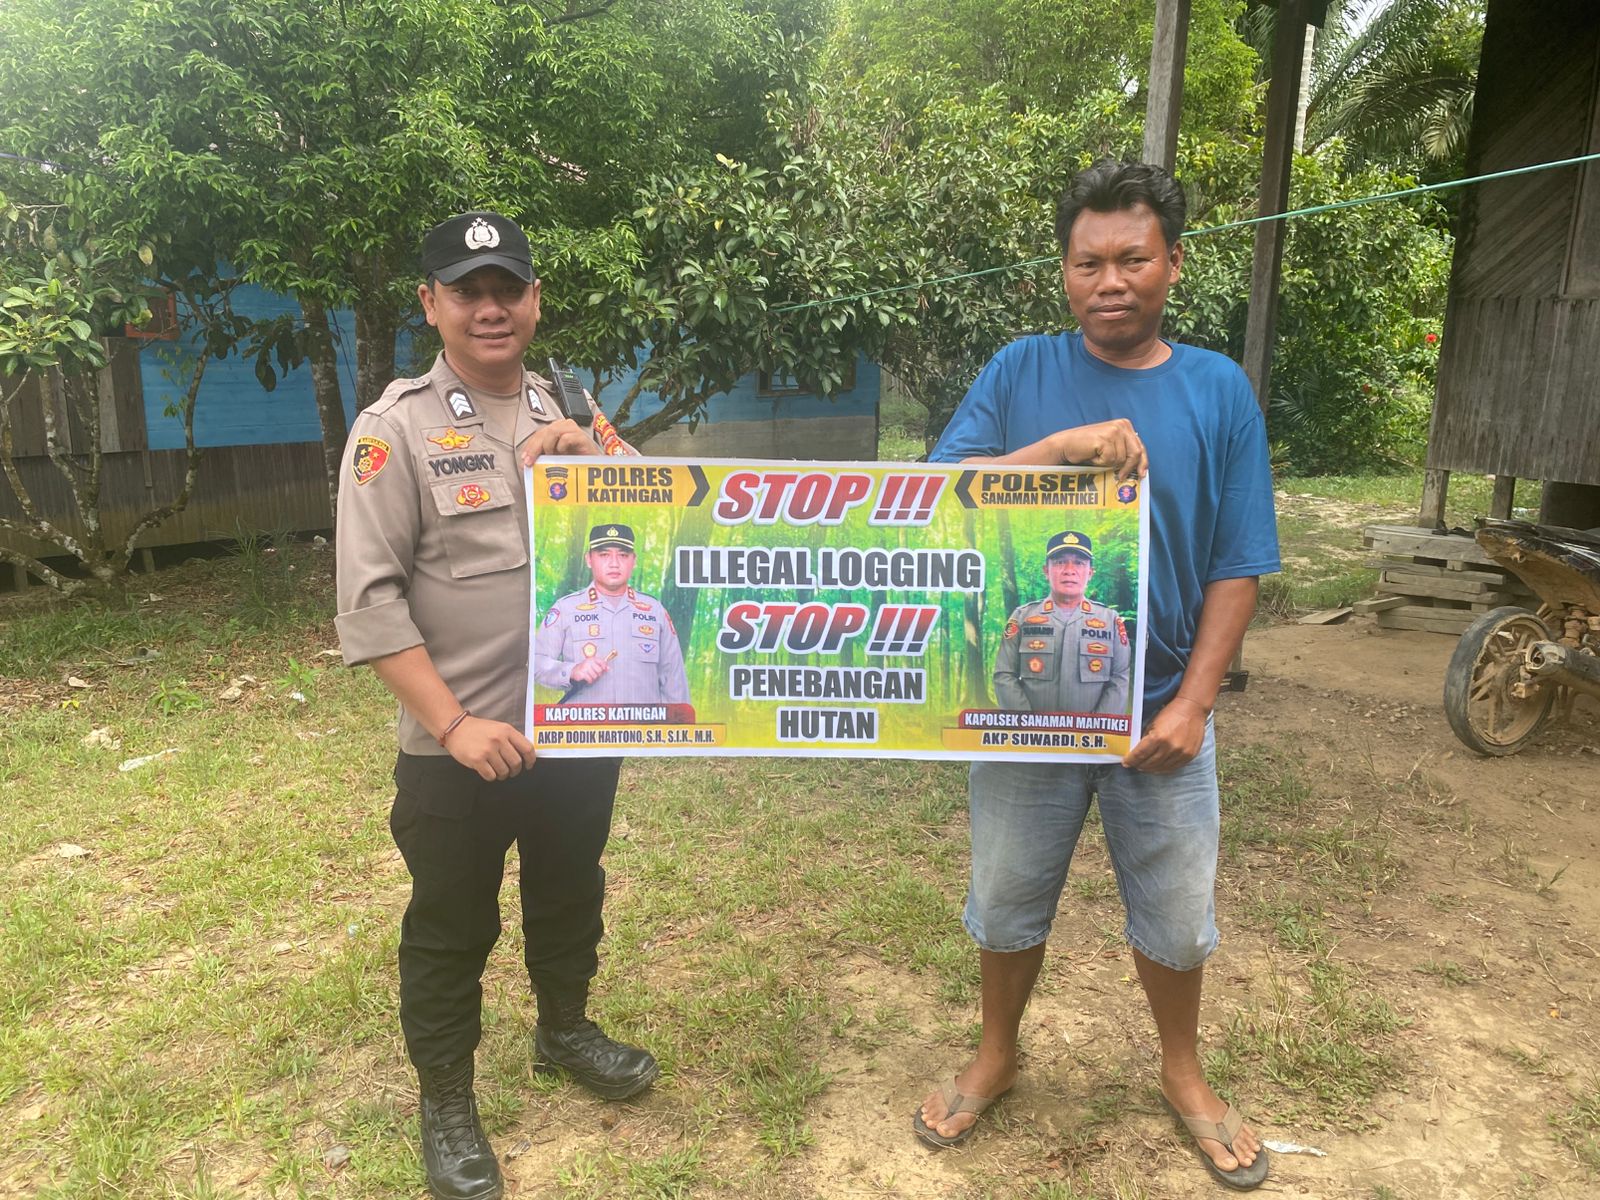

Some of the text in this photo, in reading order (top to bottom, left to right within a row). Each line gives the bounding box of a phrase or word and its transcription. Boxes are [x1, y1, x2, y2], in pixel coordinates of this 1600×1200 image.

[429, 454, 495, 477] YONGKY
[588, 467, 673, 486] POLRES
[982, 473, 1098, 492] POLSEK
[588, 488, 673, 503] KATINGAN
[717, 473, 945, 520] STOP !!!
[981, 491, 1098, 505] SANAMAN MANTIKEI
[679, 550, 981, 588] ILLEGAL LOGGING
[574, 613, 599, 622] DODIK
[720, 604, 937, 652] STOP !!!
[1081, 628, 1112, 640] POLRI
[733, 668, 922, 700] PENEBANGAN
[545, 707, 667, 721] KAPOLRES KATINGAN
[964, 713, 1129, 732] KAPOLSEK SANAMAN MANTIKEI
[780, 710, 875, 739] HUTAN
[538, 731, 564, 744] AKBP
[566, 731, 596, 744] DODIK
[598, 729, 645, 744] HARTONO,
[646, 730, 666, 743] S.H.,
[694, 730, 715, 743] M.H.
[982, 732, 1107, 748] AKP SUWARDI, S.H.
